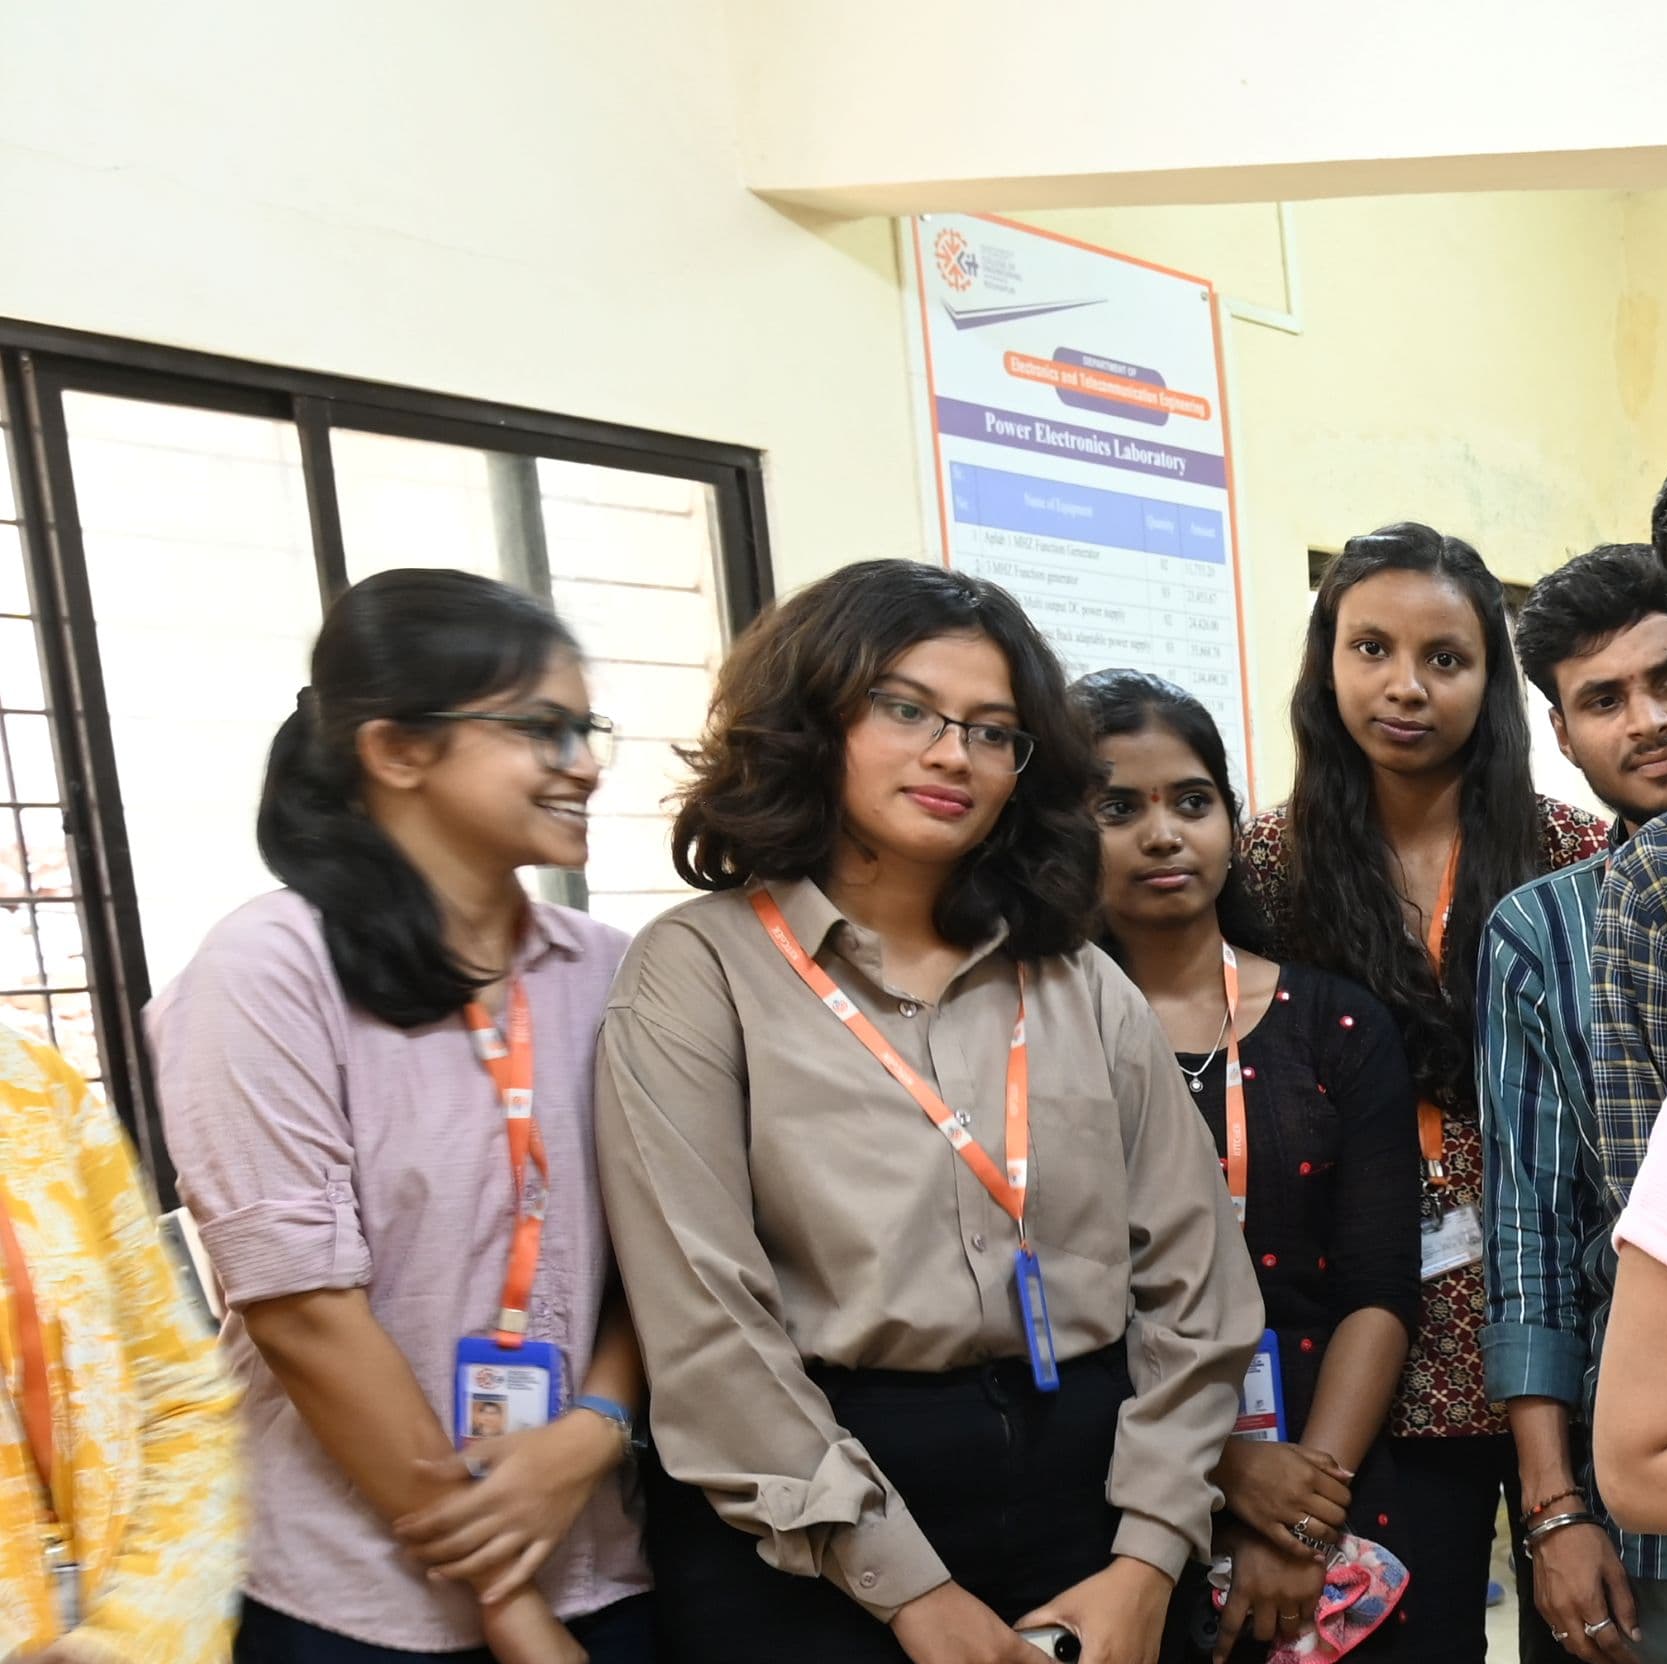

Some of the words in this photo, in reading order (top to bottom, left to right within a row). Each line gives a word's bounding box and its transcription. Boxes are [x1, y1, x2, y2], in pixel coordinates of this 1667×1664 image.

[1010, 356, 1059, 381] Electronics
[1060, 369, 1078, 387] and
[984, 411, 1032, 440] Power
[1035, 423, 1112, 458] Electronics
[1114, 439, 1187, 477] Laboratory
